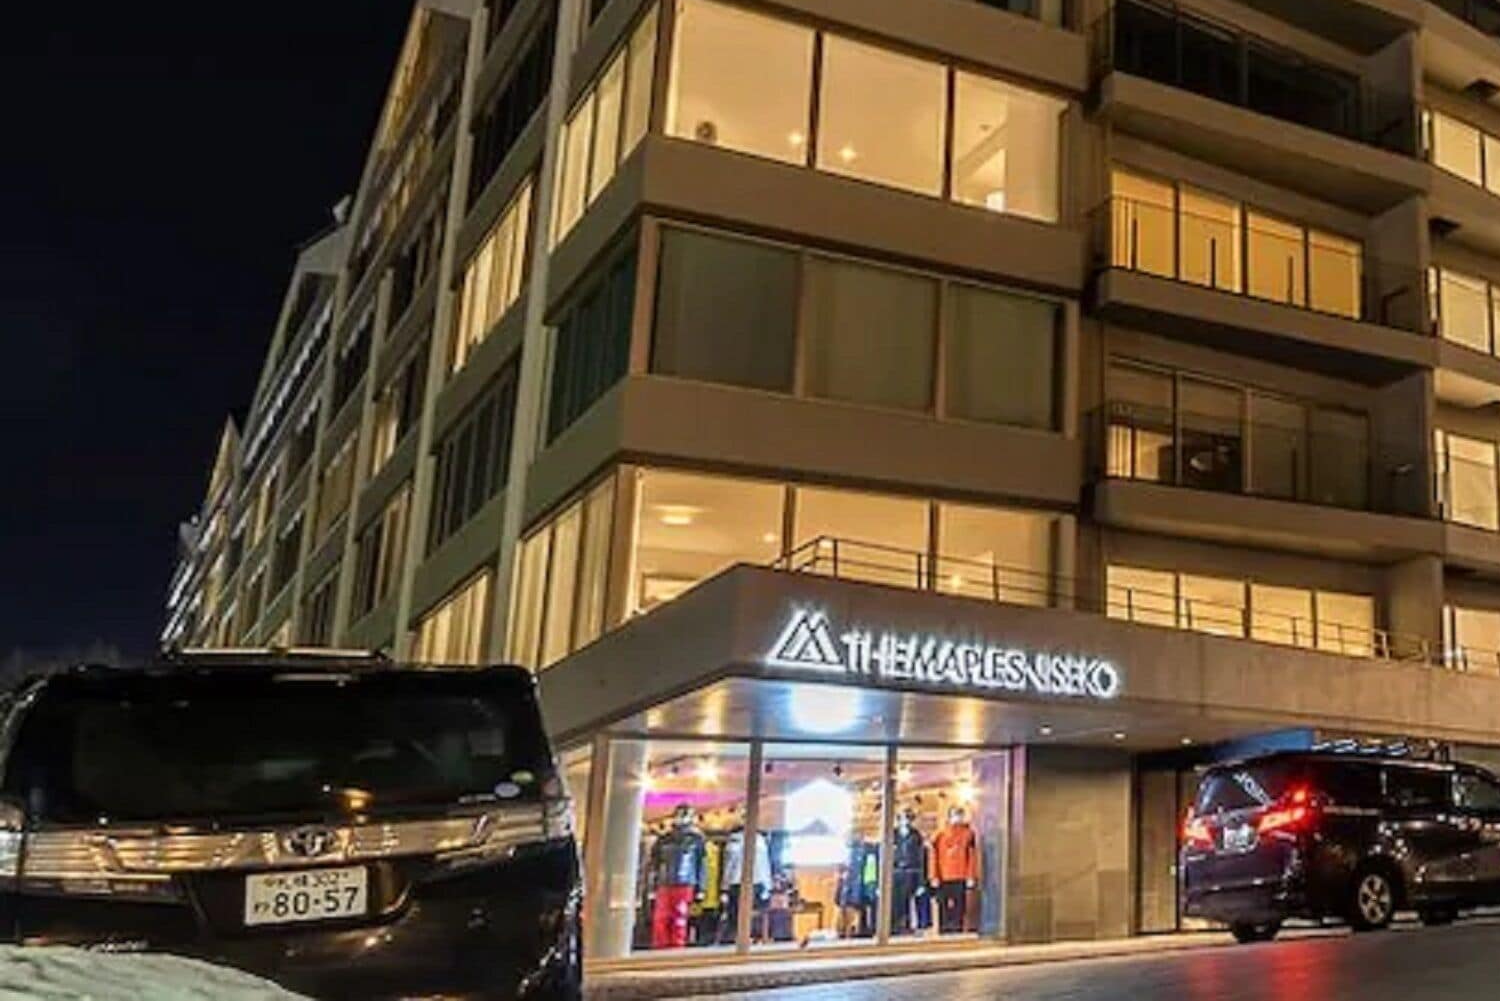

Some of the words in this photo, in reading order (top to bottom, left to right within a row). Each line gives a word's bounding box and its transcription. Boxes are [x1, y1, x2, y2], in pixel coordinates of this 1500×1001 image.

[841, 631, 917, 678] THE
[914, 637, 1027, 690] MAPLES
[1024, 652, 1120, 699] NISEKO
